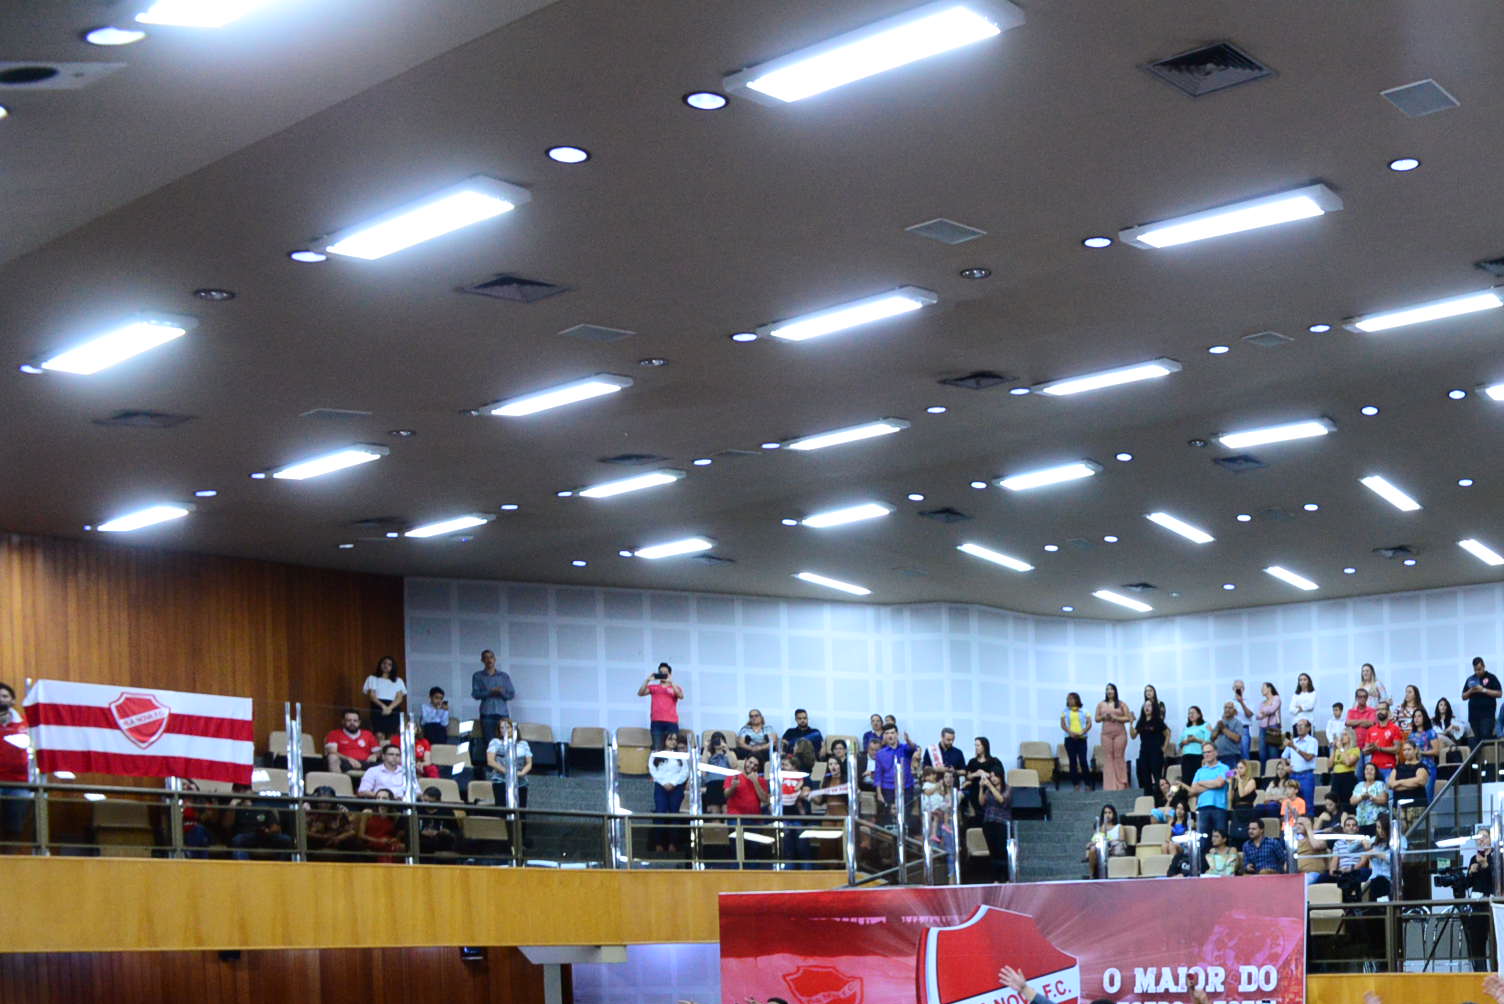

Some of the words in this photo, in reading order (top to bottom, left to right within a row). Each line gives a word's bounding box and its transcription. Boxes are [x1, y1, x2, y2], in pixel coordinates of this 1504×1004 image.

[1103, 967, 1122, 994] O
[1133, 966, 1226, 994] MAIOR
[1238, 965, 1278, 992] DO
